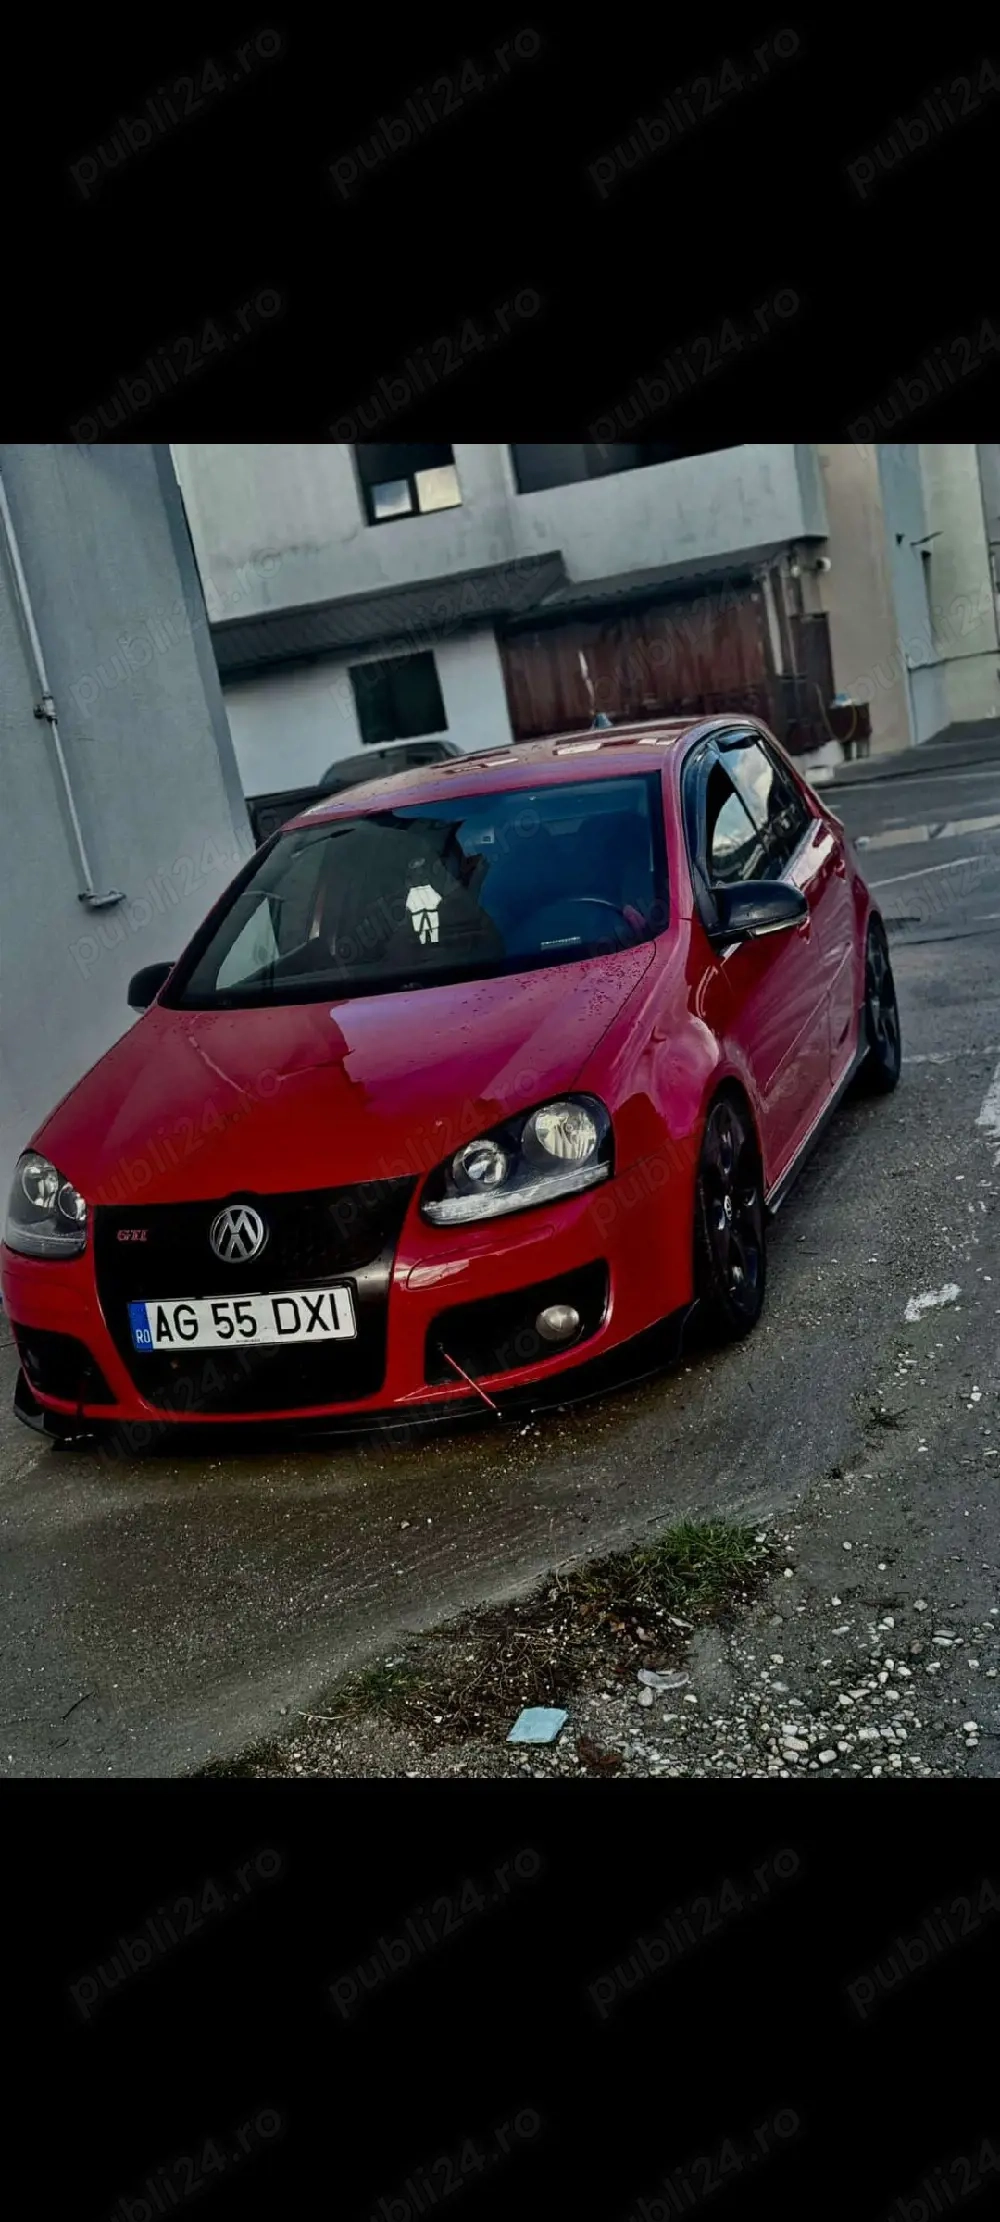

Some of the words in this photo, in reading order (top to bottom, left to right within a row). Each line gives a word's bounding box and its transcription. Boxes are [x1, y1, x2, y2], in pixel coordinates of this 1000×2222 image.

[156, 1304, 199, 1342] AG
[211, 1301, 257, 1339] 55
[271, 1293, 340, 1335] DXI
[136, 1329, 151, 1344] RO
